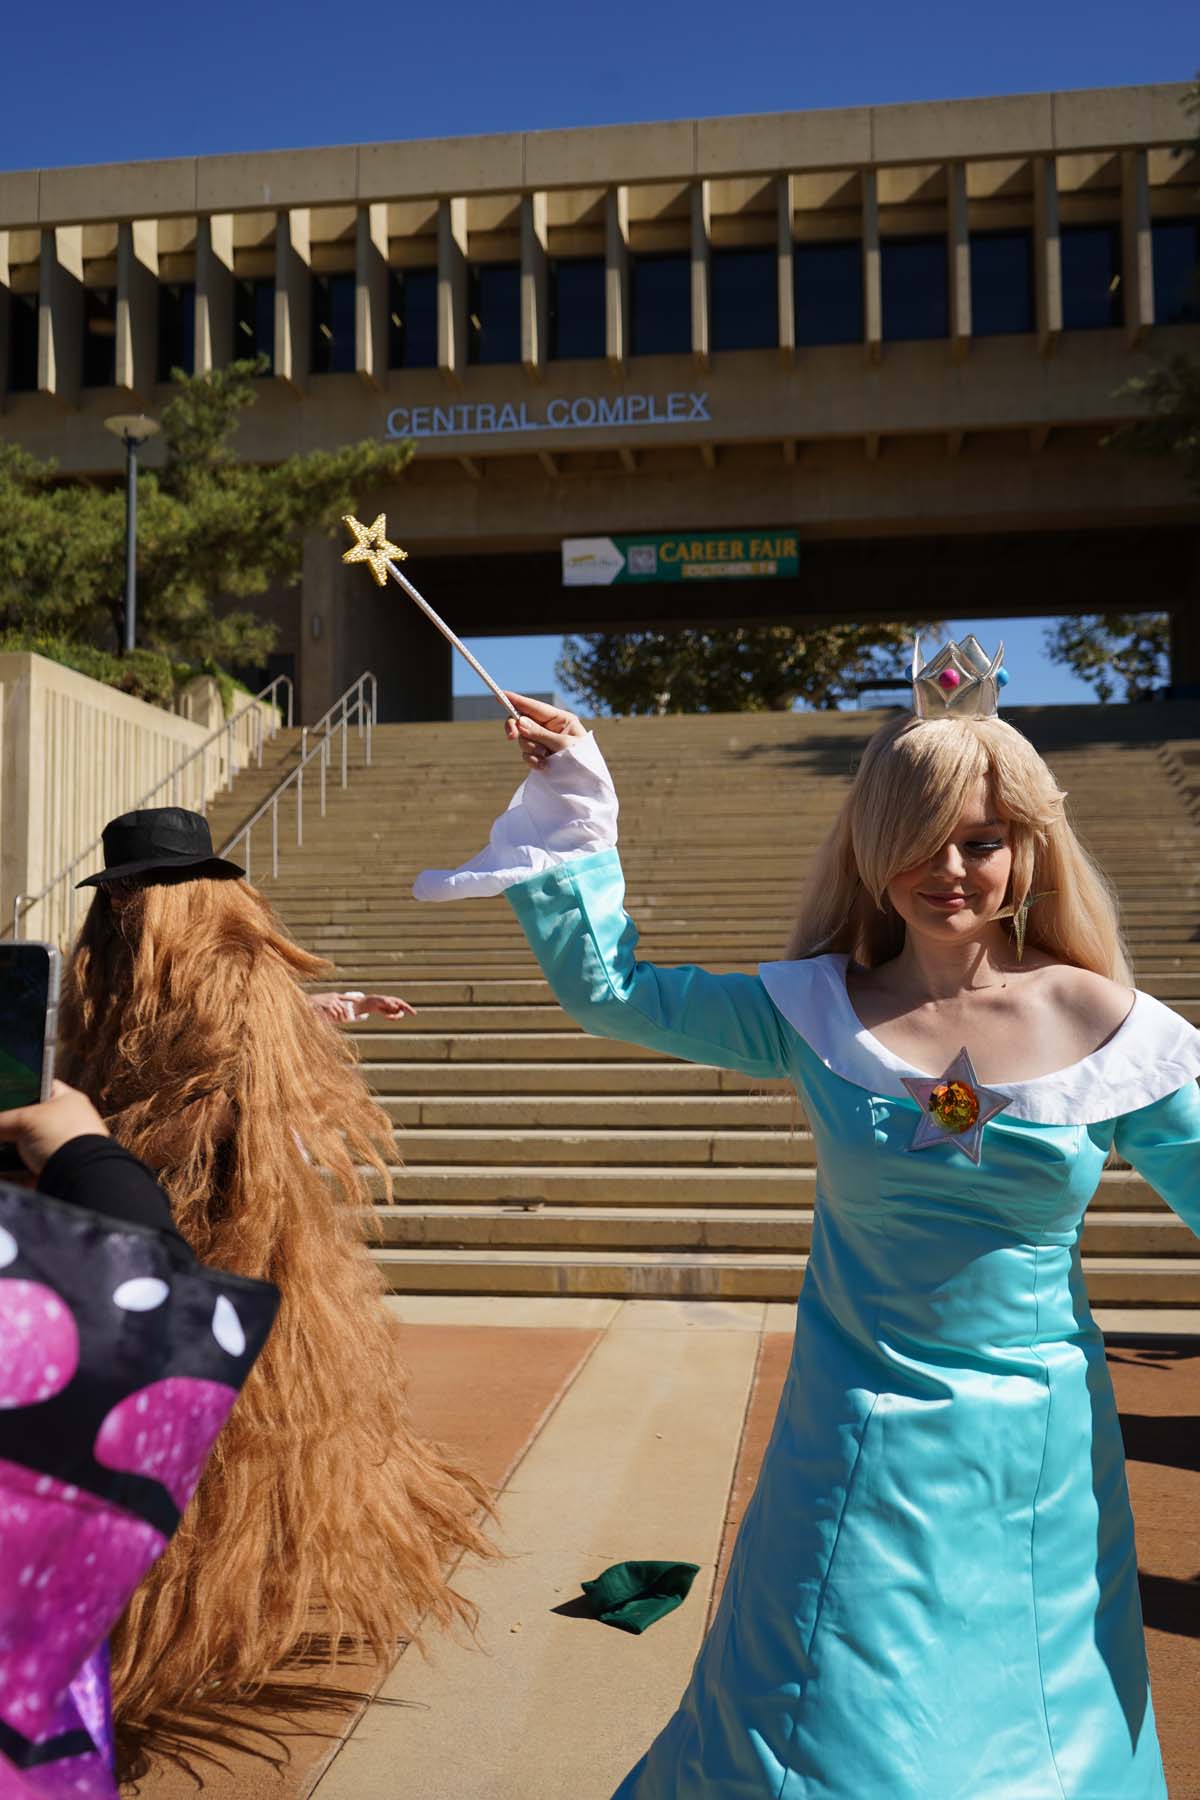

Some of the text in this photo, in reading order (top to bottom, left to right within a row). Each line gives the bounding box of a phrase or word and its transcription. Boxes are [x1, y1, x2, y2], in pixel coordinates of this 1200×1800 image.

[386, 392, 711, 436] CENTRAL COMPLEX
[659, 538, 797, 562] CAREER FAIR
